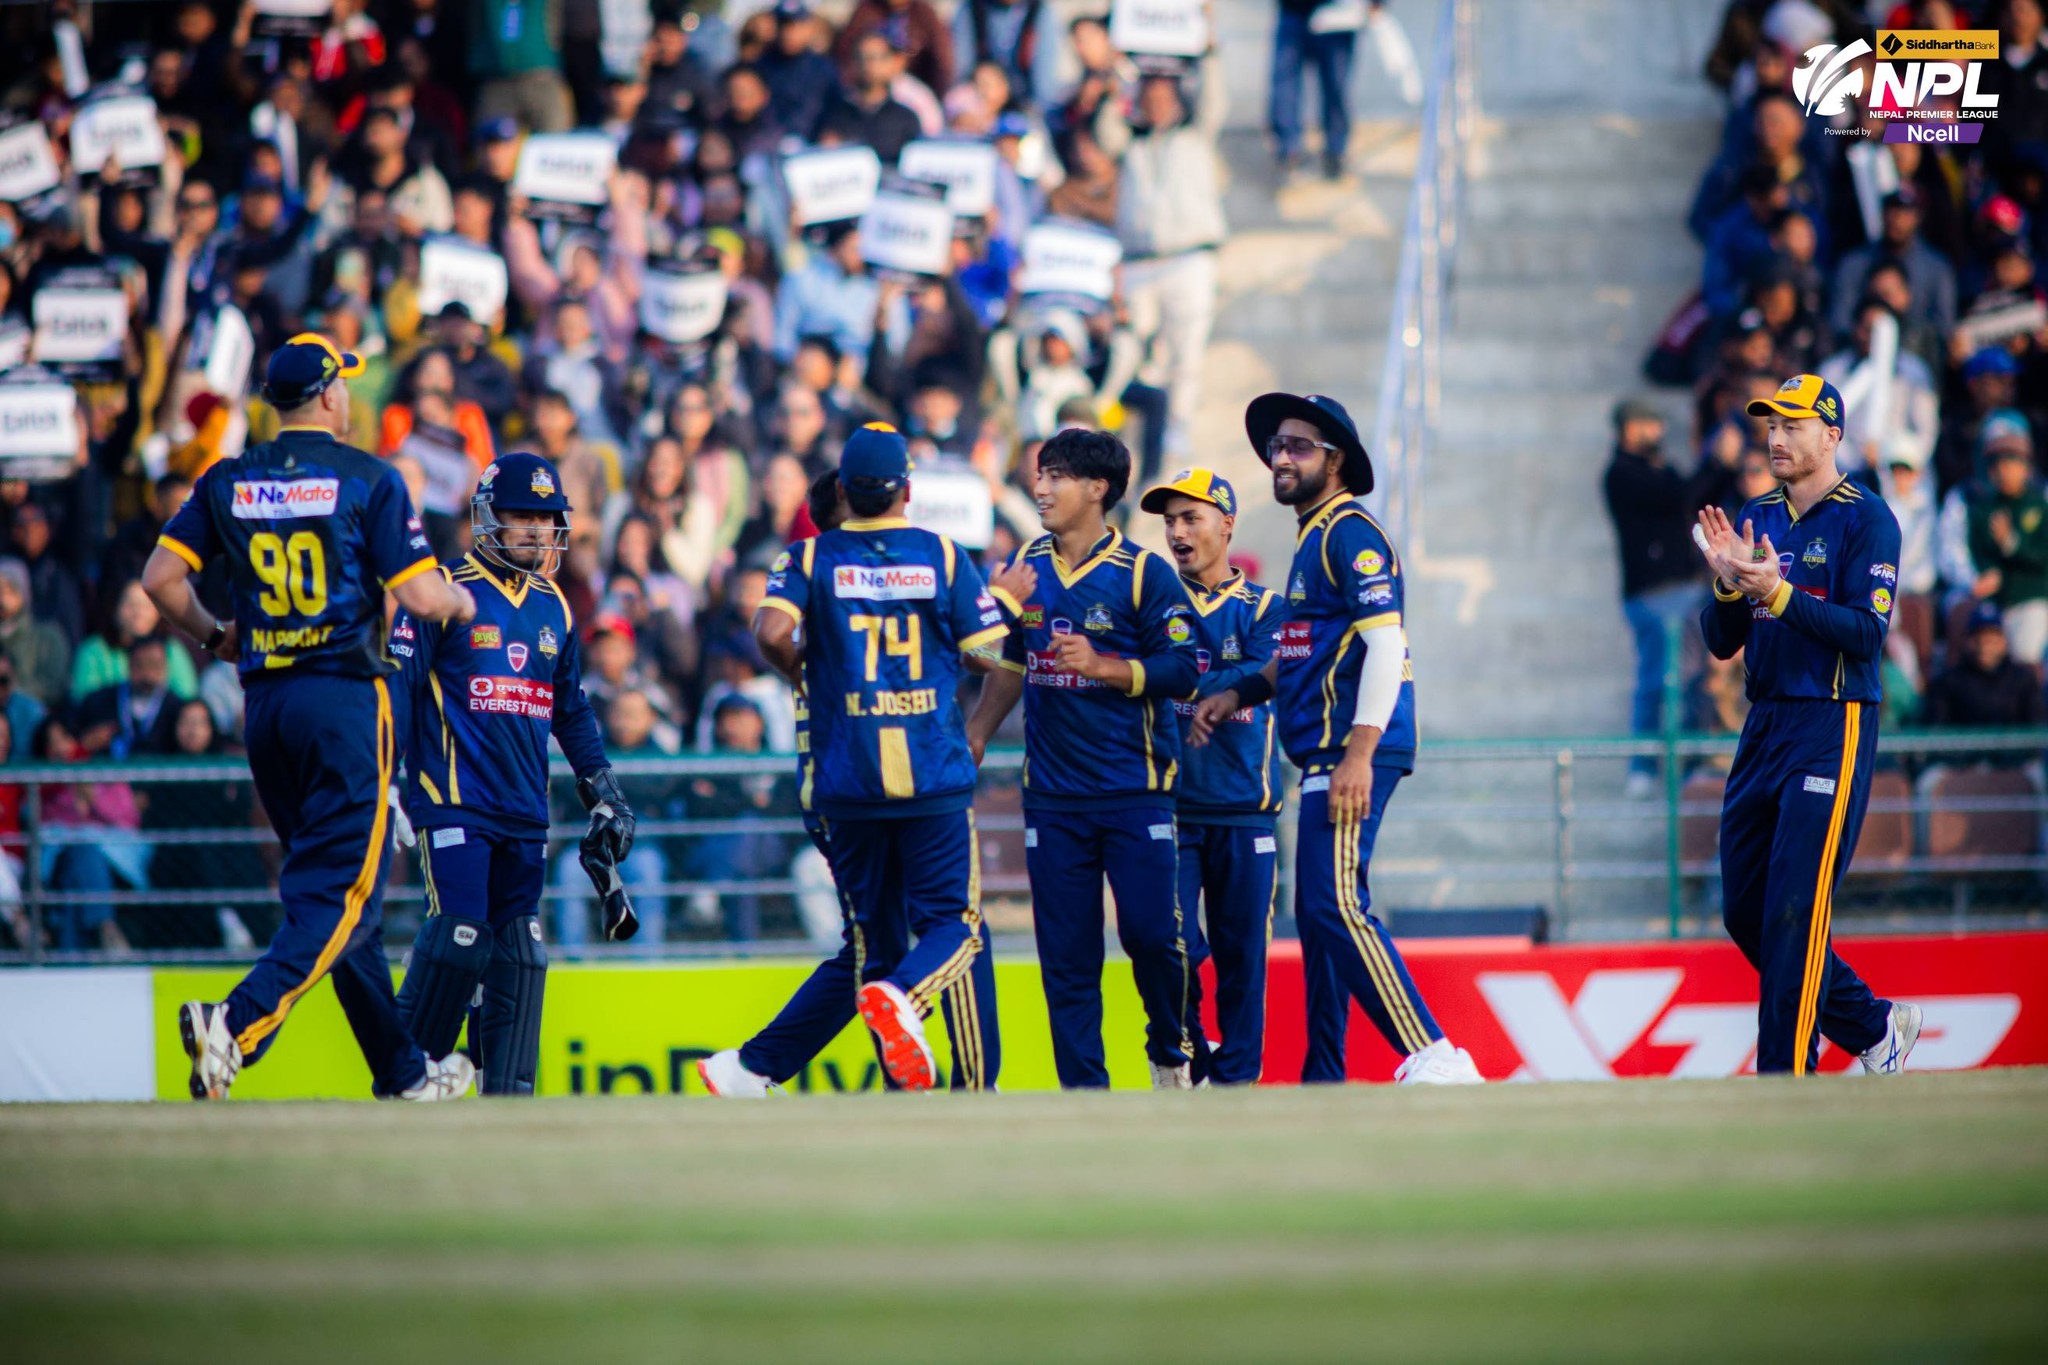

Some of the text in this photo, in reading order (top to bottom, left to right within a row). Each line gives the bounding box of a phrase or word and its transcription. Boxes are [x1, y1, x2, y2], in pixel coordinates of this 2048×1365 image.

[257, 484, 335, 504] NeMato
[249, 531, 328, 617] 90
[860, 571, 933, 587] NeMato
[849, 614, 922, 682] 74
[469, 698, 551, 718] EVEREST BANK
[870, 688, 938, 716] JOSHI
